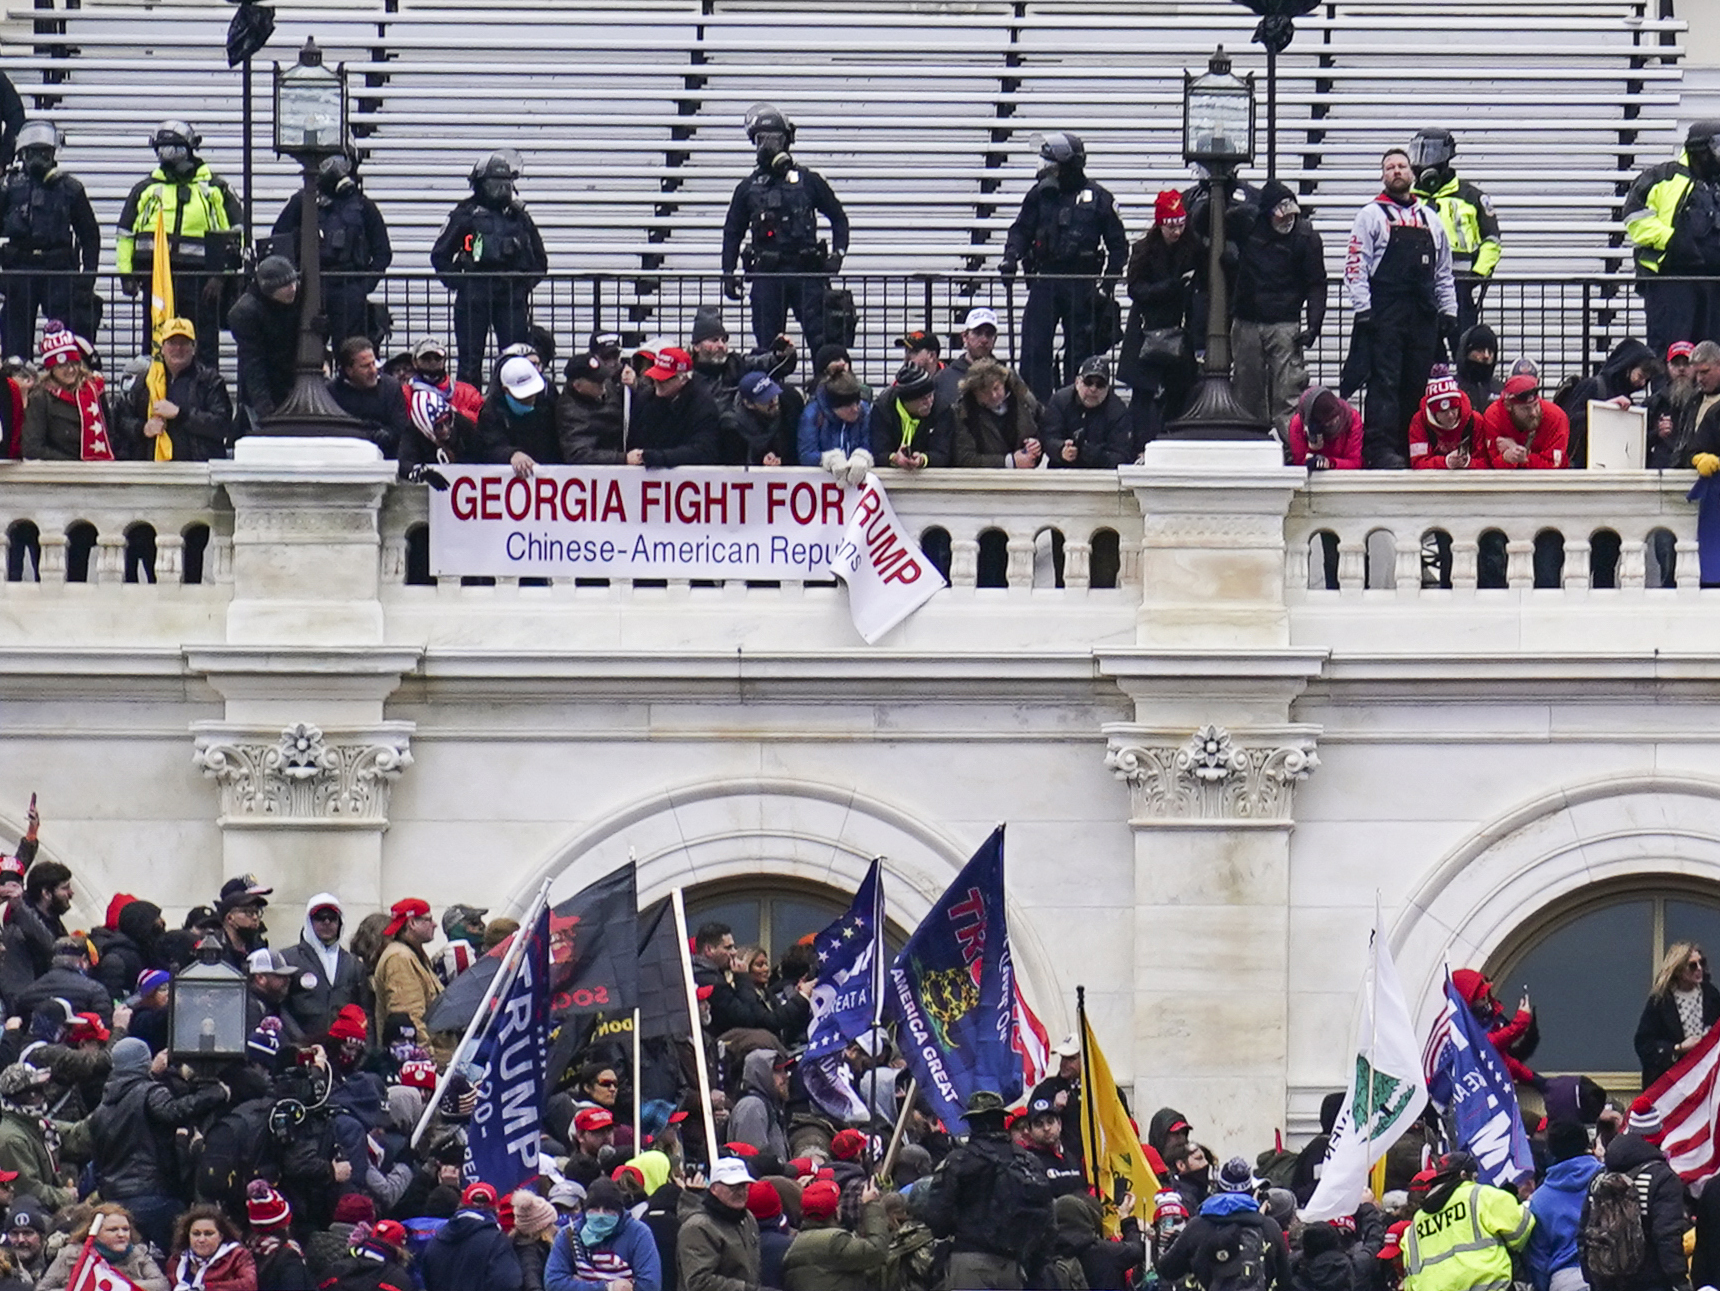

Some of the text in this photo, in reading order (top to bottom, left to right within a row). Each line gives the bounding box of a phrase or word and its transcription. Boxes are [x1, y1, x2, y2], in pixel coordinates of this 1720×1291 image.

[450, 476, 627, 523] GEORGIA
[641, 481, 754, 525] FIGHT
[767, 482, 845, 526] FOR
[506, 531, 760, 565] Chinese-American
[500, 953, 541, 1168] TRUMP
[890, 968, 959, 1103] AMERICA GREAT
